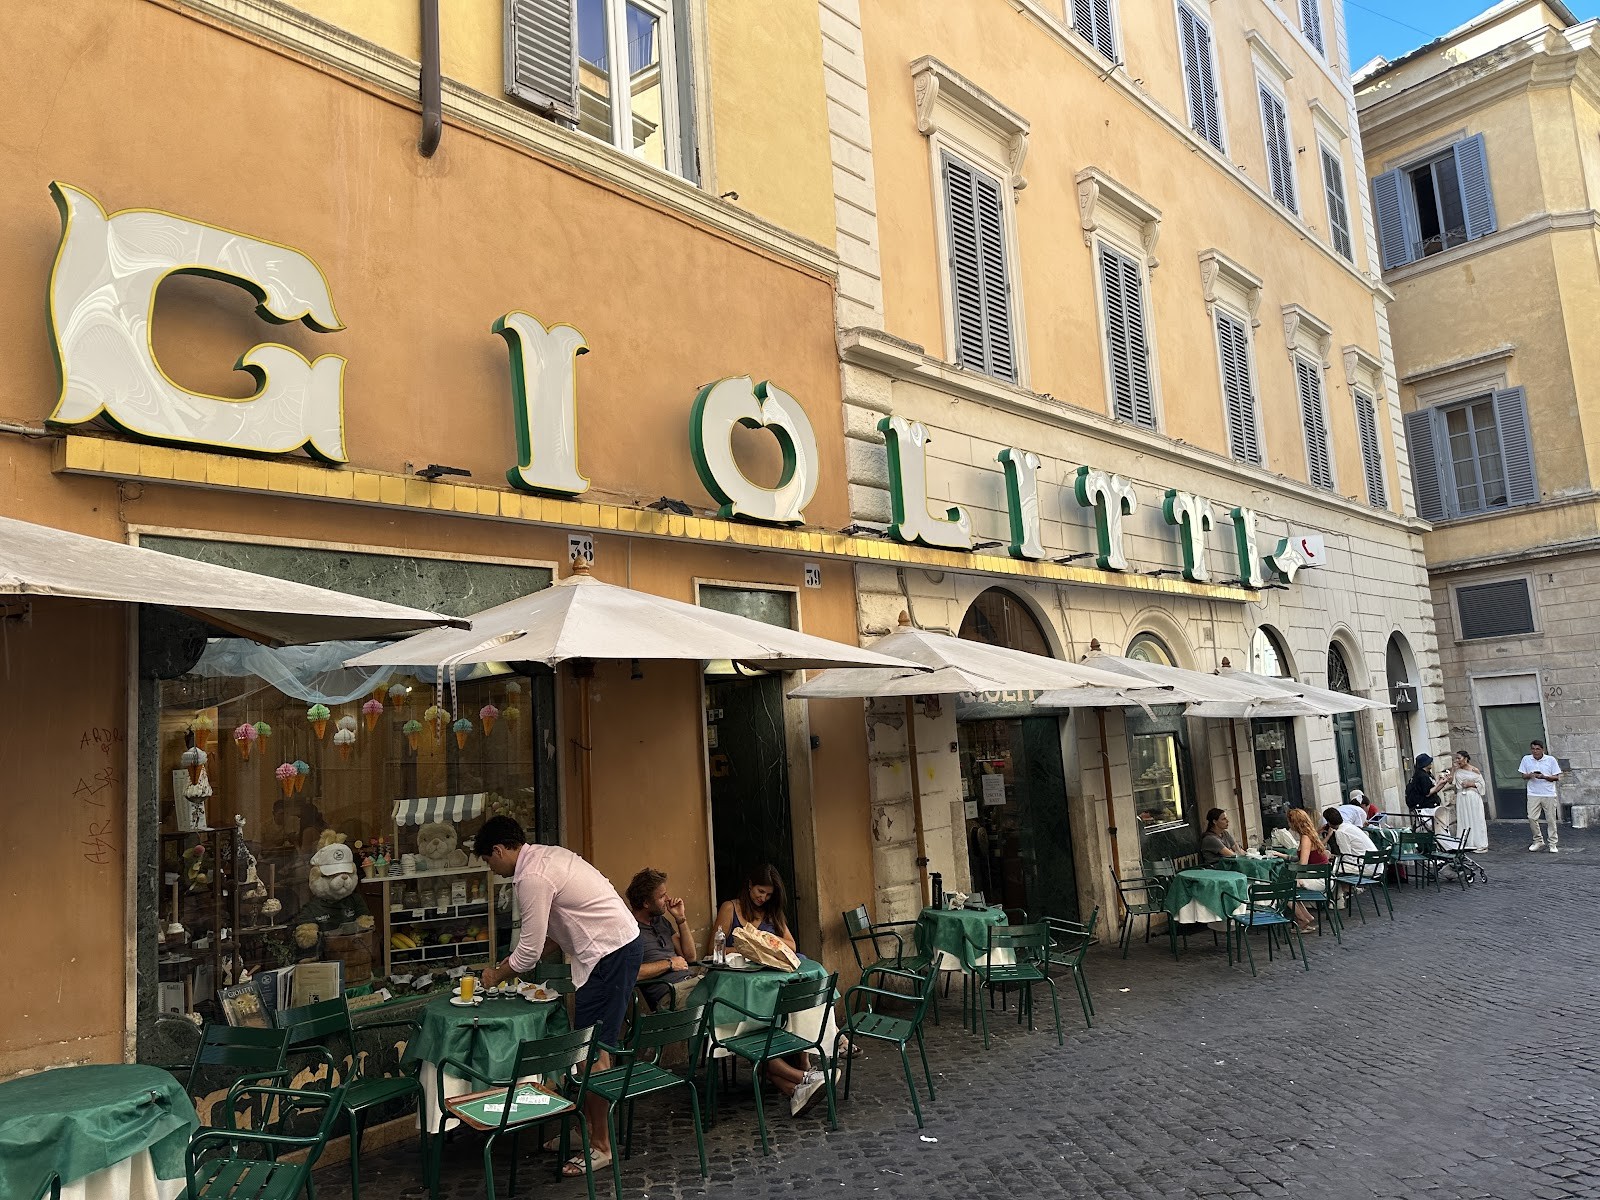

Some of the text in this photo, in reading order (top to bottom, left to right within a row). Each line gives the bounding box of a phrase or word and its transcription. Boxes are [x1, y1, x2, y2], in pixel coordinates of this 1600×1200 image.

[45, 180, 1265, 592] GIOLITTI
[570, 539, 594, 562] 38
[805, 568, 821, 586] 39
[1549, 686, 1563, 697] 20
